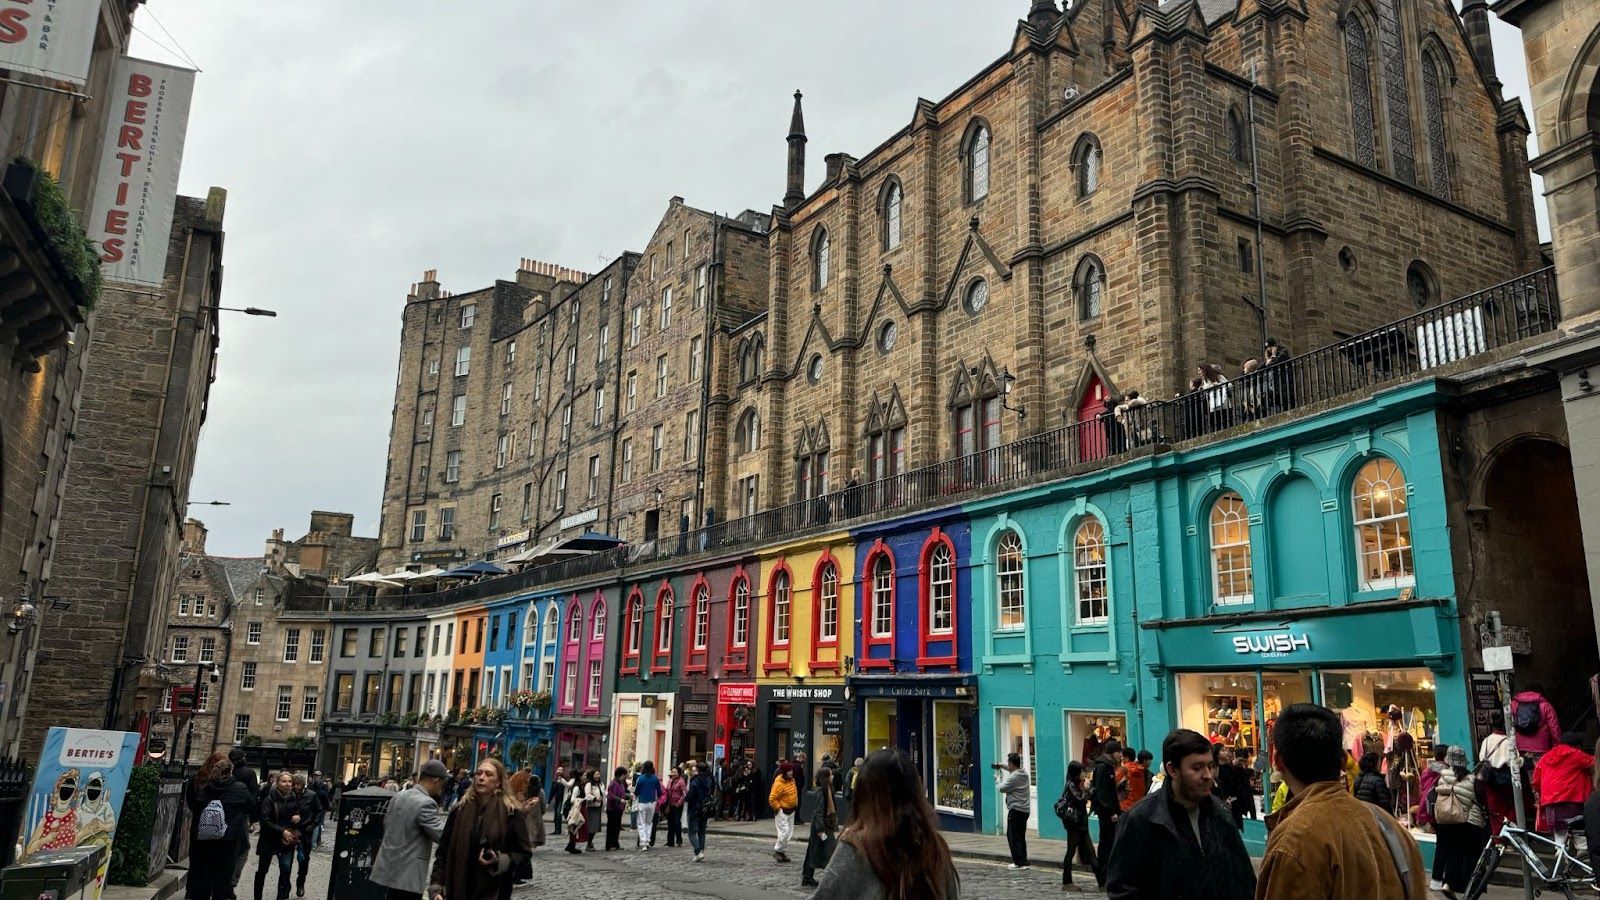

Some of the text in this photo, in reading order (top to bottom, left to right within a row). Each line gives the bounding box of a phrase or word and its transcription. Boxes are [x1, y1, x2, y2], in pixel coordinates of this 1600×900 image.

[39, 25, 50, 50] BAR
[156, 79, 167, 113] PROPER
[152, 113, 161, 136] FISH
[101, 73, 153, 263] BERTIES
[146, 144, 156, 173] CHIPS
[135, 181, 150, 239] RESTAURANT
[130, 248, 139, 266] BAR
[1232, 633, 1310, 653] SWISH
[773, 687, 832, 698] THE WHISKY SHOP
[67, 748, 115, 759] BERTIE'S
